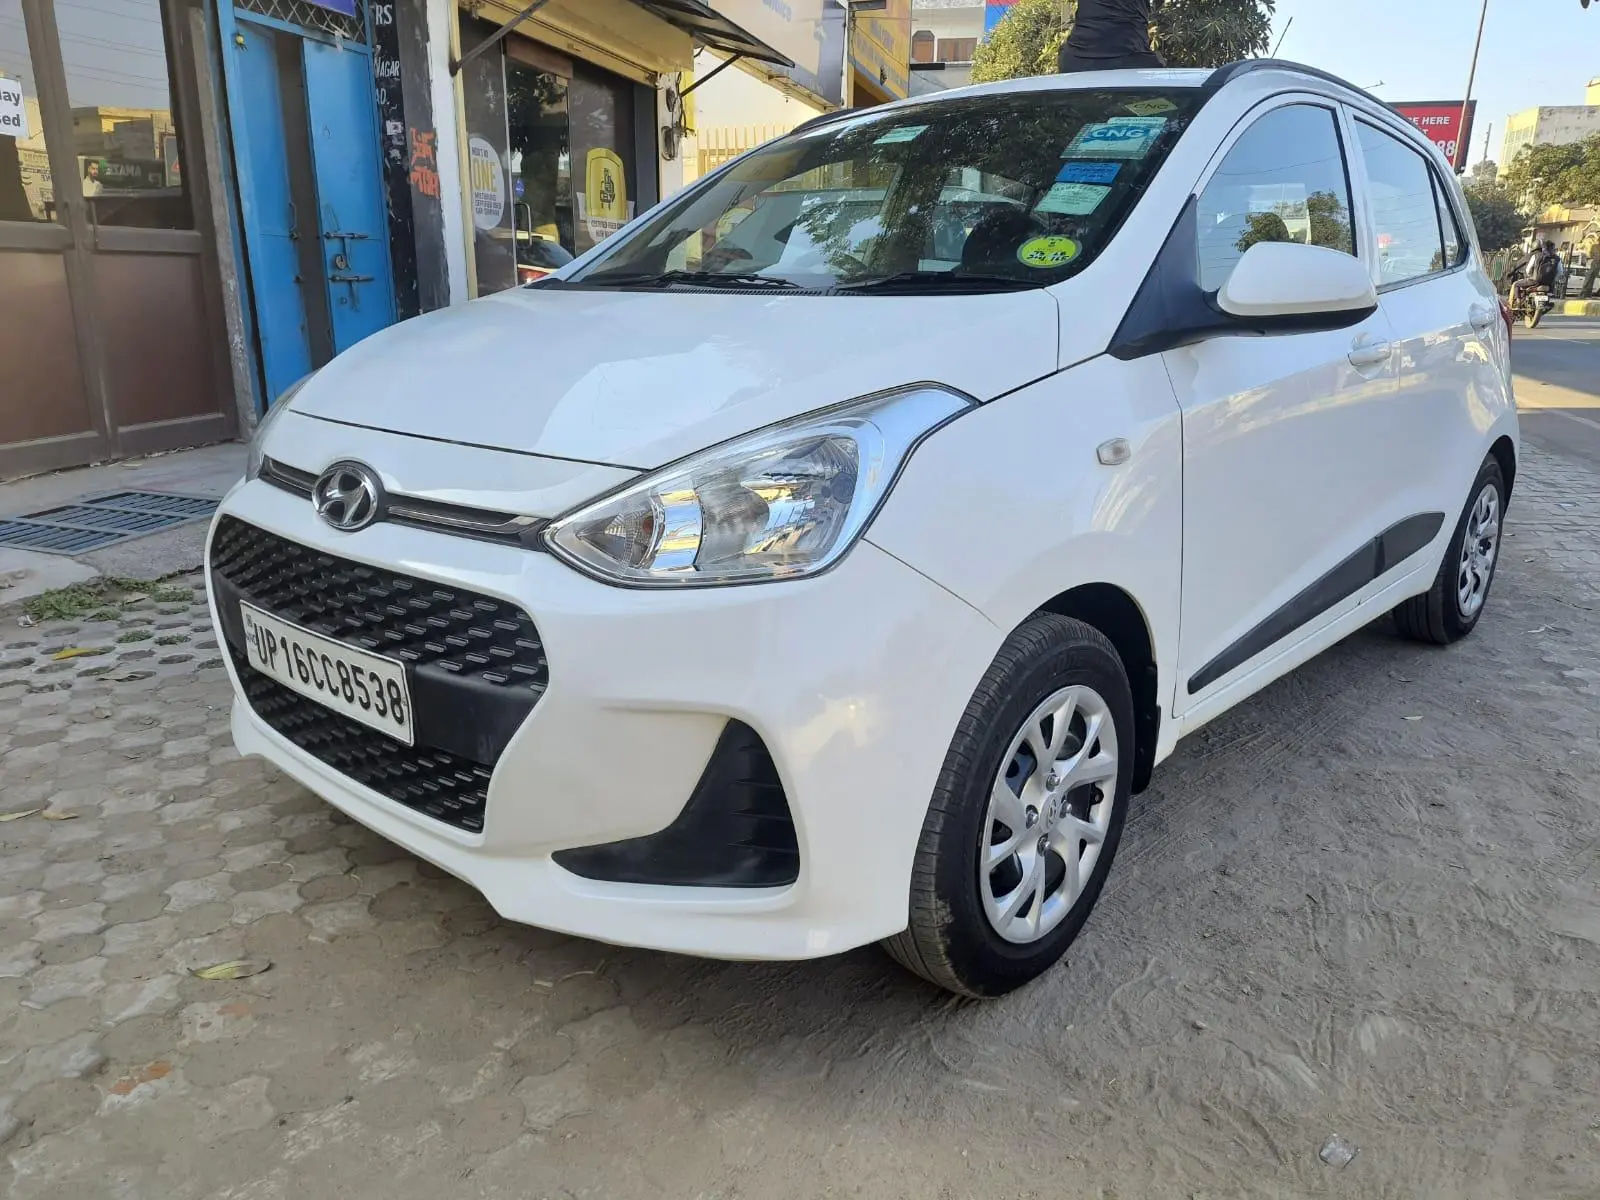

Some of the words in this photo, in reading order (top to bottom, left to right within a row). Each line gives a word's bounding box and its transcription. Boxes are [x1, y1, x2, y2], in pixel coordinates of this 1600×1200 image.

[0, 90, 20, 107] ay
[1422, 116, 1450, 125] HERE
[1091, 128, 1145, 138] CNG
[472, 158, 498, 193] ONE
[254, 622, 404, 726] UP16CC8538
